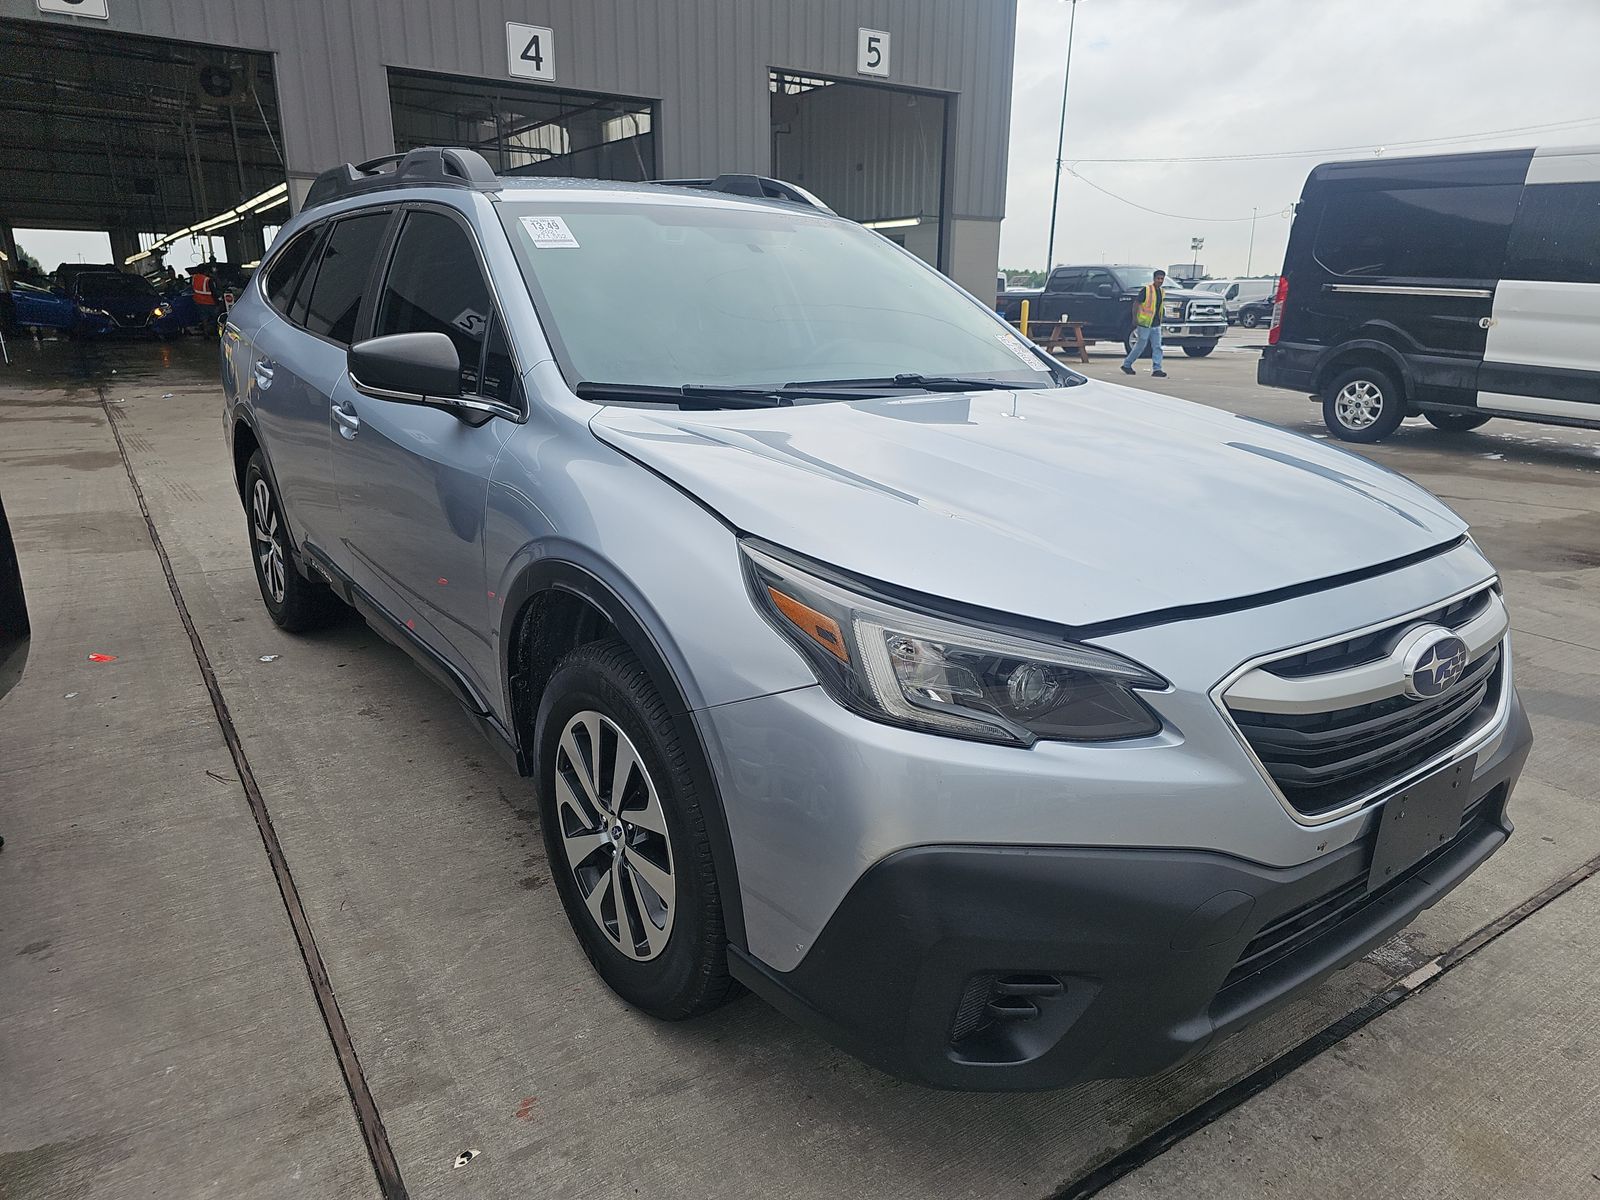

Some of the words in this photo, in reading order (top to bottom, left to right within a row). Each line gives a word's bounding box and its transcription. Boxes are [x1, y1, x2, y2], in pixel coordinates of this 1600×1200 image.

[520, 35, 543, 71] 4
[867, 37, 881, 67] 5
[531, 222, 560, 230] 13:49
